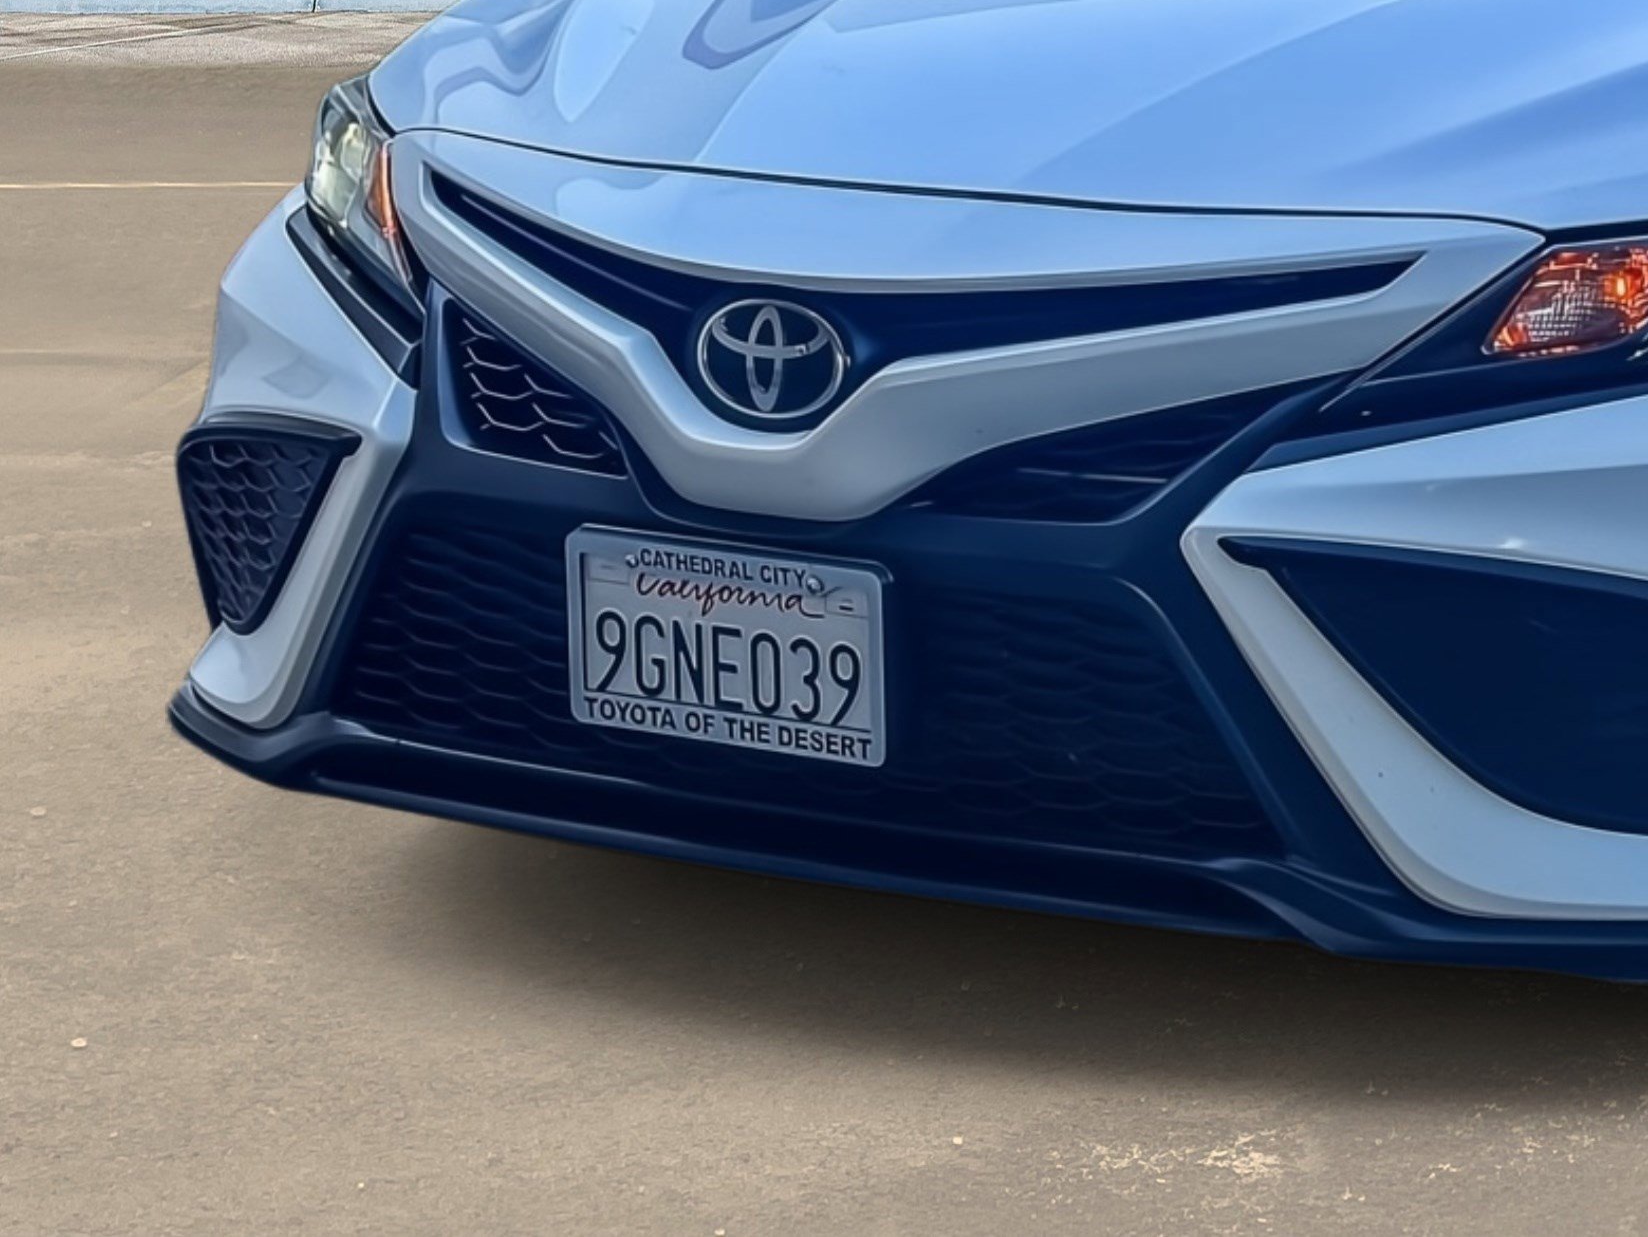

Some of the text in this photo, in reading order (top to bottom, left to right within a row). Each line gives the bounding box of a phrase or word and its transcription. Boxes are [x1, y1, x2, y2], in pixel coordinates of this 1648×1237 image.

[640, 548, 807, 588] CATHEDRAL CITY
[595, 609, 861, 728] 9GNE039
[583, 696, 872, 760] TOYOTA OF THE DESERT
